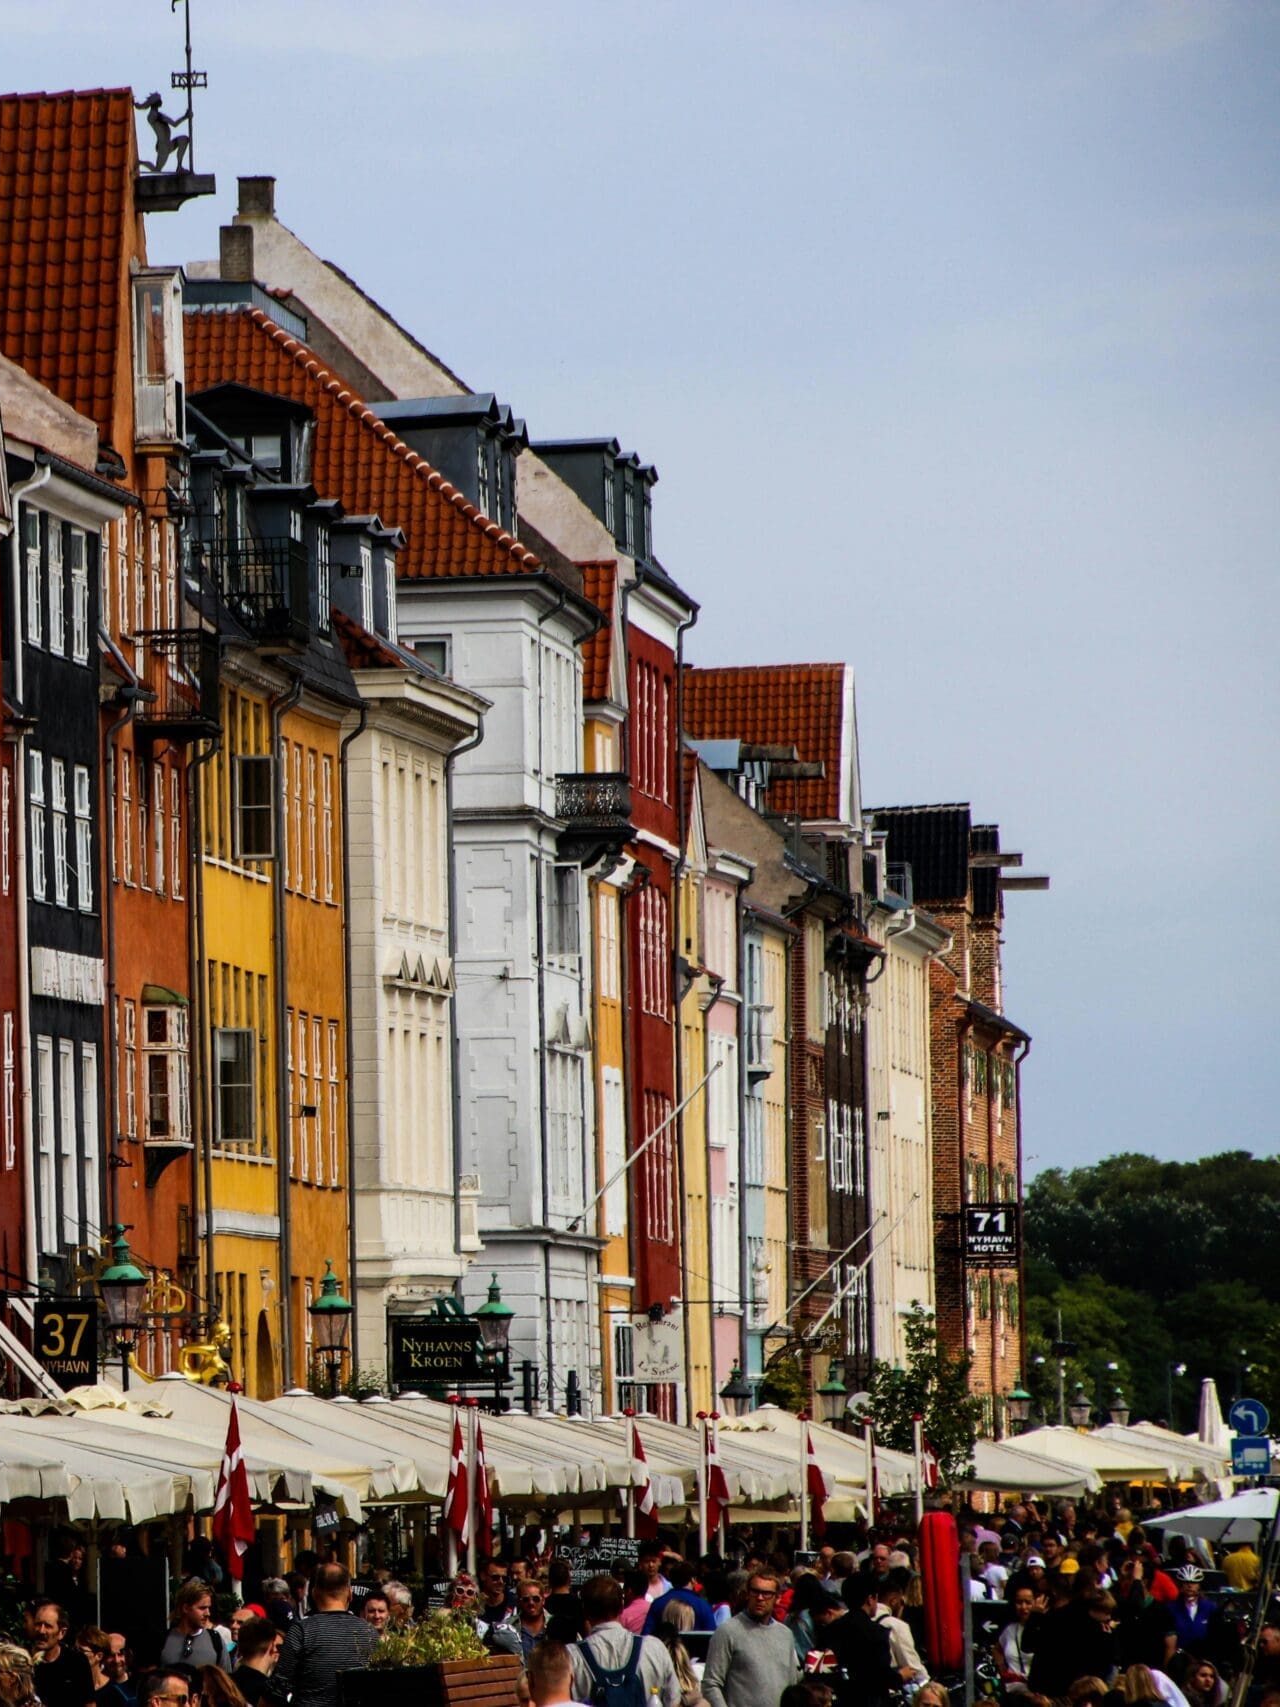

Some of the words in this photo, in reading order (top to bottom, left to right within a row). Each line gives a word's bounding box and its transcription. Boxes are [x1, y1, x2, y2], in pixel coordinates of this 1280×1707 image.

[974, 1212, 1006, 1232] 71
[974, 1244, 1009, 1252] HOTEL
[42, 1314, 89, 1357] 37
[402, 1338, 472, 1352] NYHAVNS
[42, 1360, 89, 1374] NYHAVN
[410, 1353, 463, 1368] KROEN
